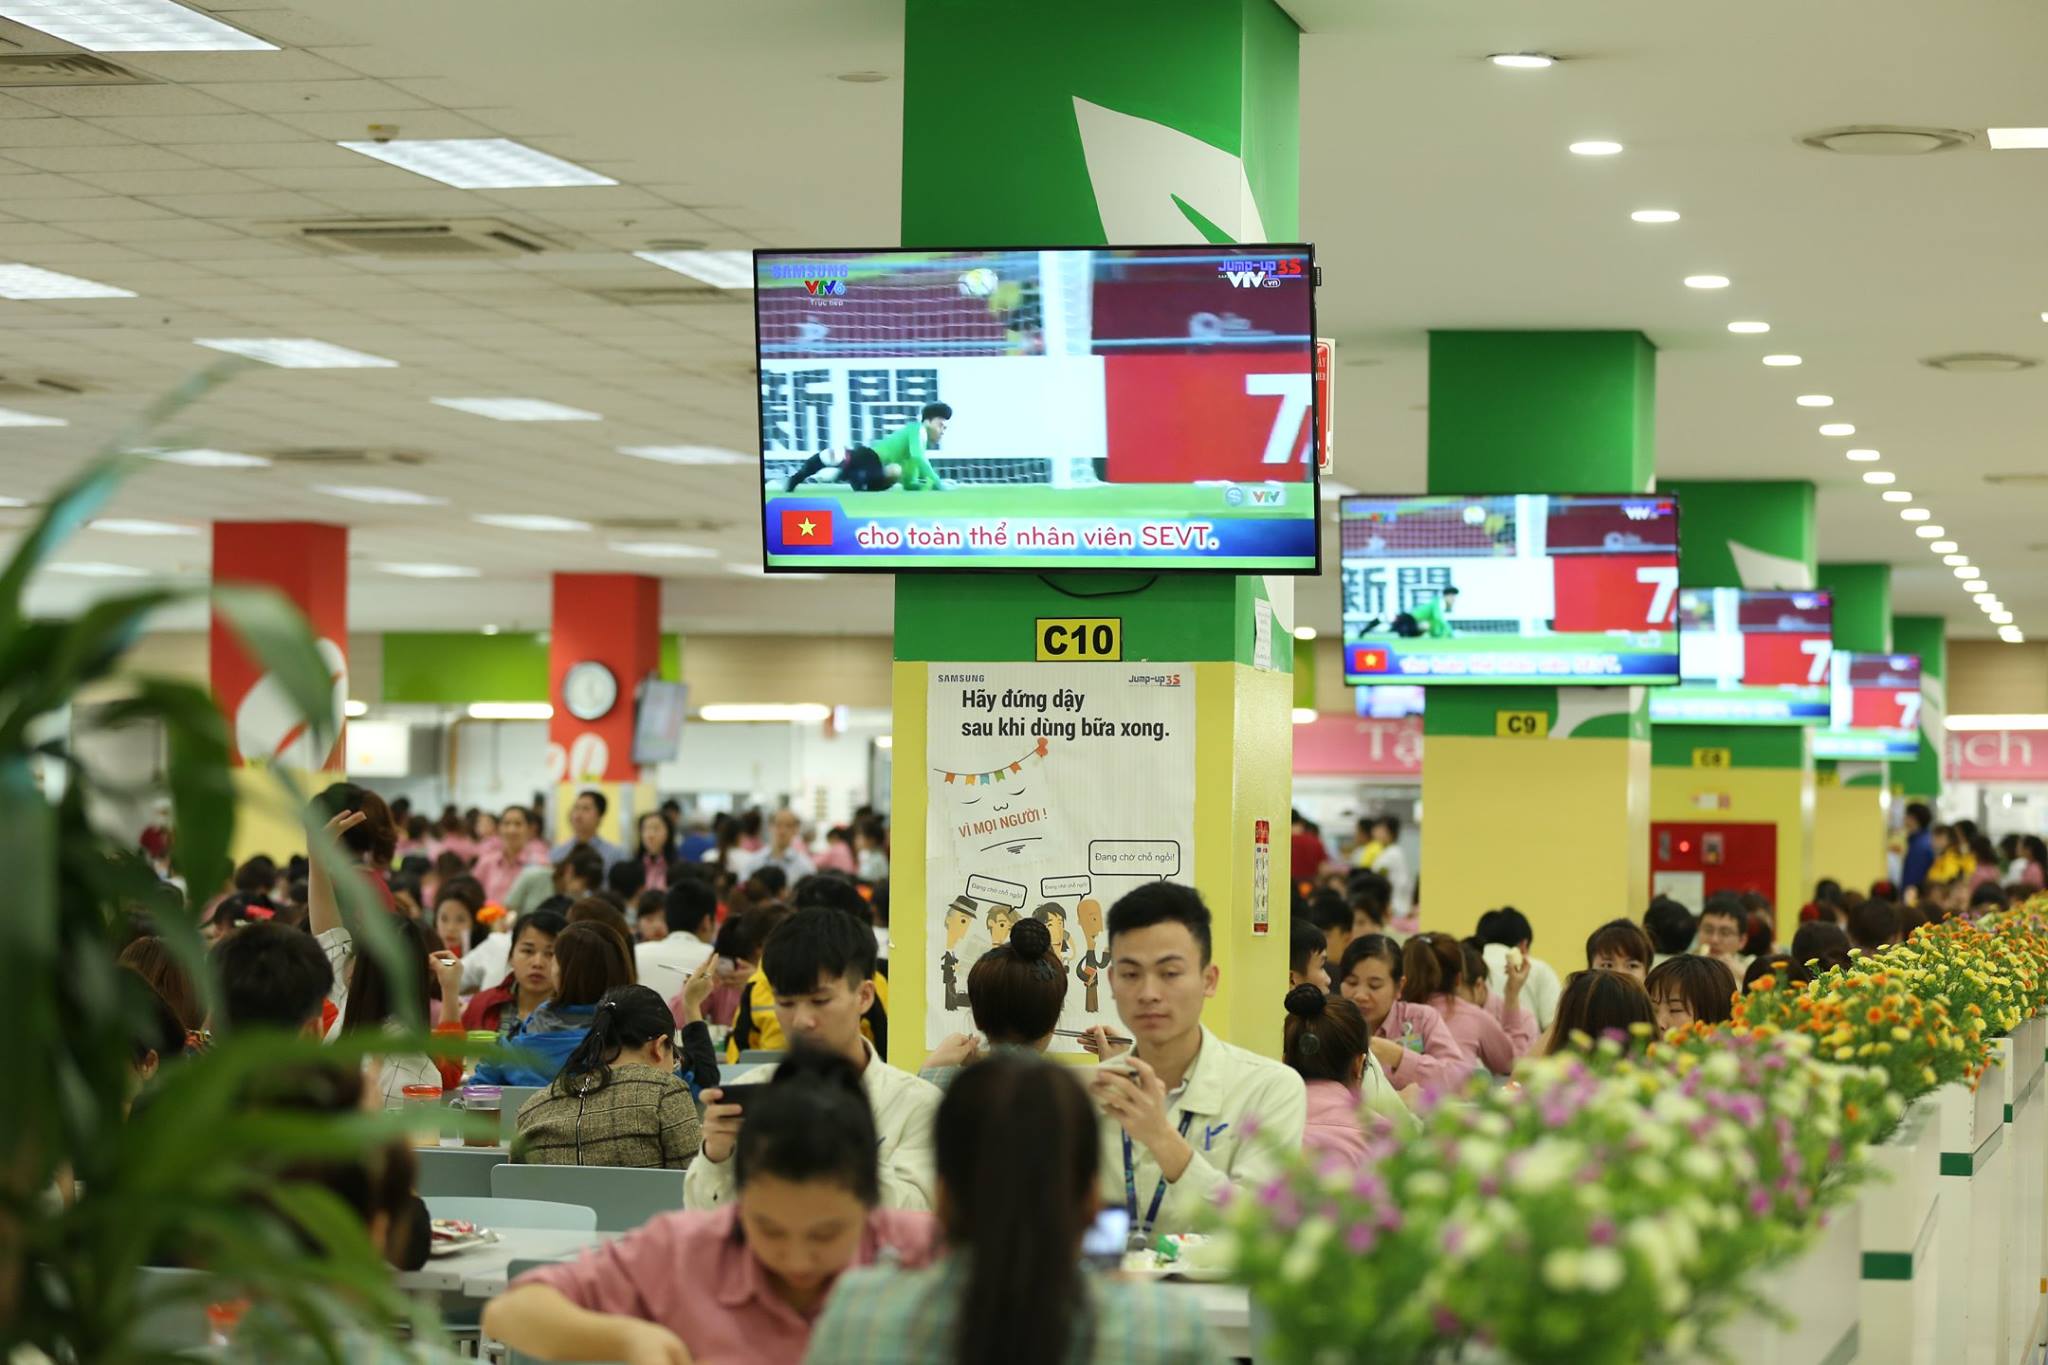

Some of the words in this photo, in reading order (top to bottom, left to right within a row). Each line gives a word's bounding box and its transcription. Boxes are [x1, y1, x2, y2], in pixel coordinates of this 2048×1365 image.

[805, 280, 846, 295] VTV6
[857, 525, 899, 546] cho
[908, 526, 960, 546] toàn
[969, 521, 1008, 546] thể
[1016, 526, 1075, 546] nhân
[1084, 527, 1132, 546] viên
[1142, 525, 1216, 547] SEVT.
[1044, 624, 1113, 655] C10
[938, 674, 985, 683] SAMSUNG
[962, 689, 996, 712] Hãy
[1002, 688, 1047, 712] đứng
[1053, 689, 1085, 712] dậy
[962, 721, 993, 737] sau
[999, 717, 1025, 737] khi
[1031, 717, 1076, 741] dùng
[1082, 717, 1115, 737] bữa
[1120, 721, 1170, 741] xong.
[1507, 716, 1536, 733] C9
[958, 821, 971, 838] VÌ
[974, 819, 998, 835] MỌI
[1000, 808, 1041, 830] NGƯỜI
[1095, 852, 1117, 863] Đang
